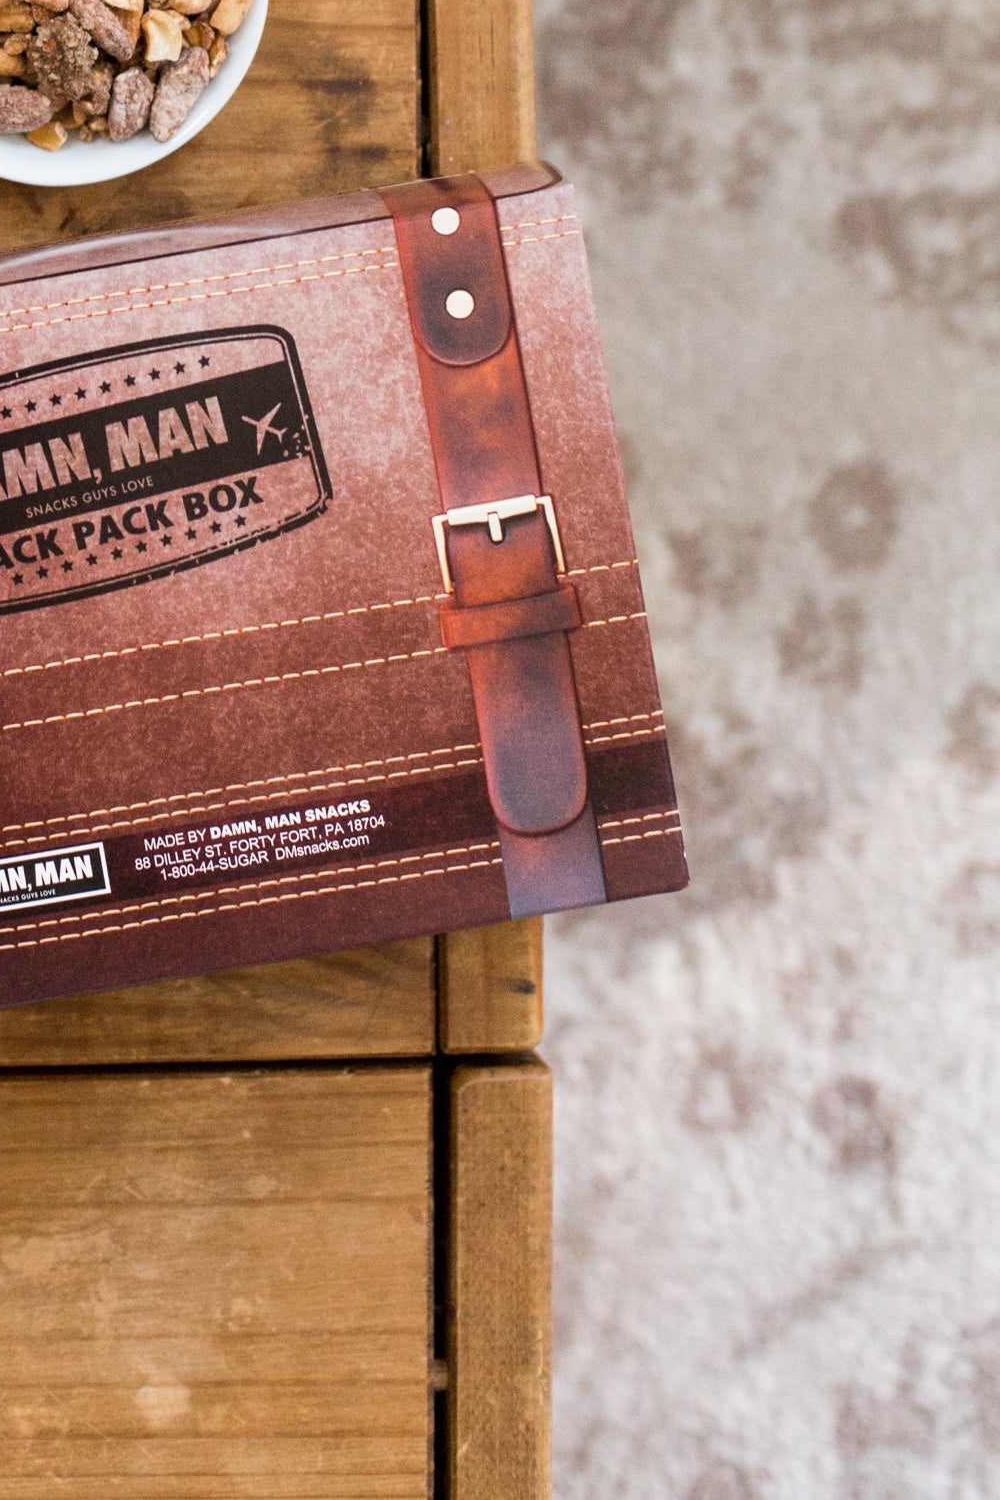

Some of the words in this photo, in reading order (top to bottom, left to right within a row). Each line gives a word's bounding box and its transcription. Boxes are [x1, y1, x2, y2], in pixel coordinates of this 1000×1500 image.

[105, 396, 230, 474] MAN
[26, 496, 78, 518] SNACKS
[82, 486, 118, 506] GUYS
[121, 476, 154, 496] LOVE
[74, 499, 173, 551] PACK
[184, 476, 264, 524] BOX
[135, 856, 151, 870] 88
[154, 846, 201, 867] DILLEY
[205, 843, 226, 858] ST.
[230, 834, 276, 854] FORTY
[280, 826, 322, 844] FORT,
[324, 822, 344, 836] PA
[348, 814, 386, 832] 18704
[144, 832, 185, 852] MADE
[188, 828, 206, 844] BY
[210, 820, 262, 839] DAMN,
[265, 812, 302, 830] MAN
[304, 800, 370, 822] SNACKS
[34, 854, 94, 887] MAN
[160, 850, 269, 880] 1-800-44-SUGAR
[275, 834, 370, 860] DMsnacks.com
[21, 891, 38, 900] GUYS
[40, 888, 56, 898] LOVE
